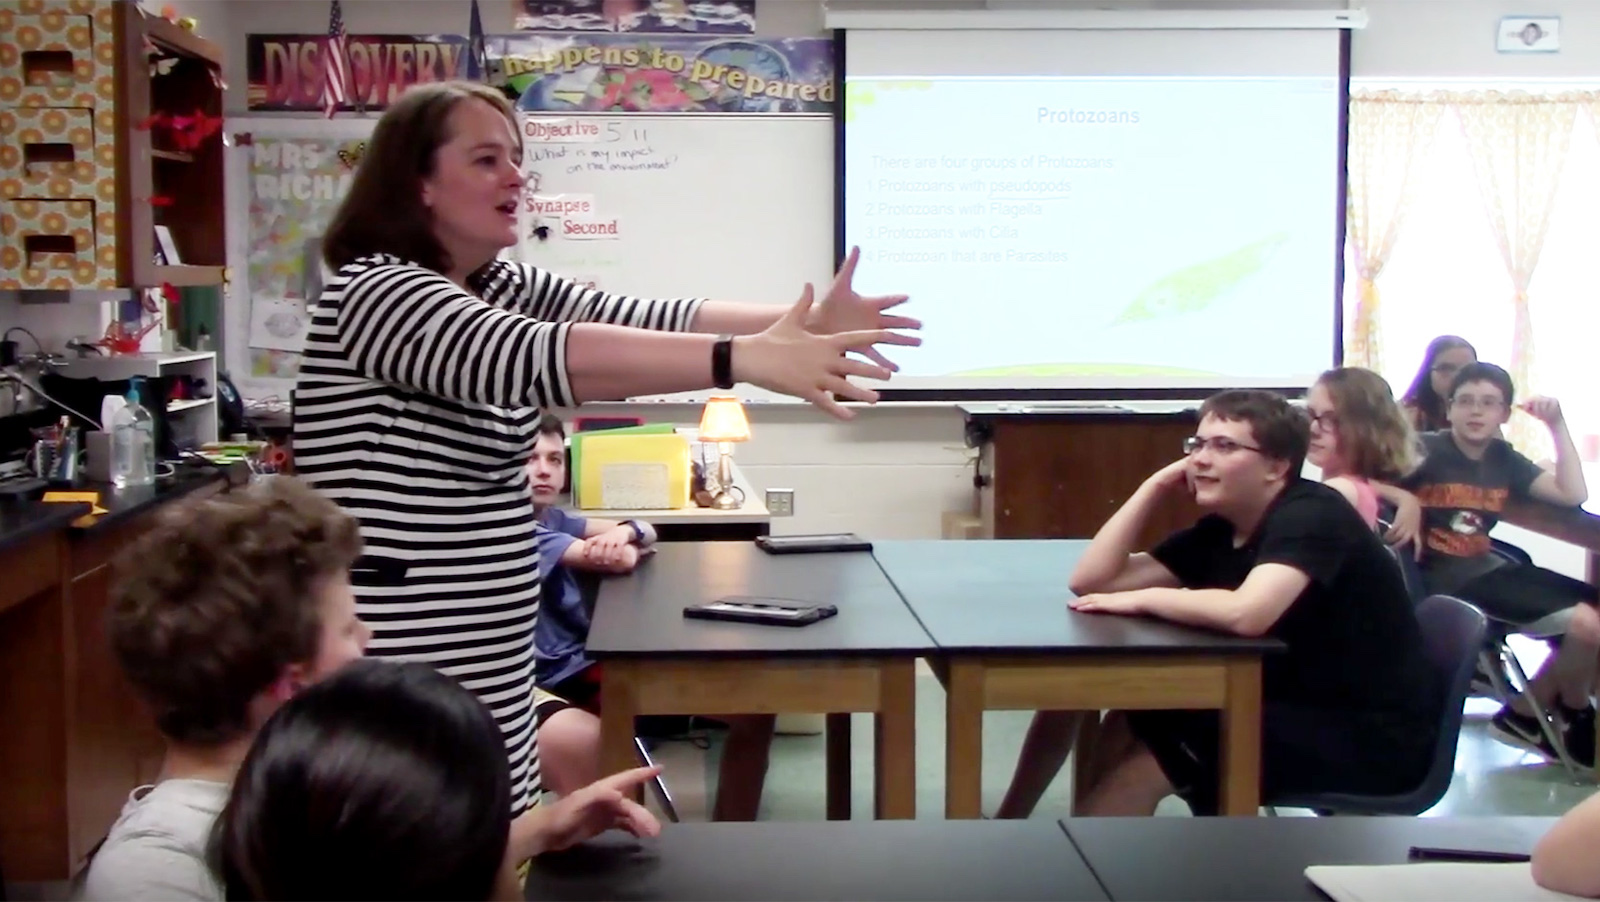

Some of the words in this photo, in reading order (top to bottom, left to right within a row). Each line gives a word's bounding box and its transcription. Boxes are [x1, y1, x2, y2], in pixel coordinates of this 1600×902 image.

[263, 41, 463, 106] DISOVERY
[502, 44, 640, 78] happens
[651, 46, 685, 73] to
[690, 57, 834, 103] prepared
[1037, 106, 1140, 124] Protozoans
[525, 121, 599, 141] Objective
[528, 146, 569, 163] What
[871, 155, 911, 168] There
[914, 158, 937, 168] are
[940, 155, 968, 168] four
[970, 157, 1017, 172] groups
[1021, 154, 1035, 168] of
[958, 179, 985, 192] with
[990, 179, 1072, 195] pseudopods
[525, 197, 591, 216] Synapse
[958, 203, 985, 216] with
[989, 203, 1042, 219] Flagella
[563, 219, 618, 235] Second
[958, 226, 985, 239] with
[988, 225, 1019, 239] Cilia
[951, 248, 977, 263] that
[979, 252, 1002, 263] are
[1005, 248, 1069, 263] Parasites
